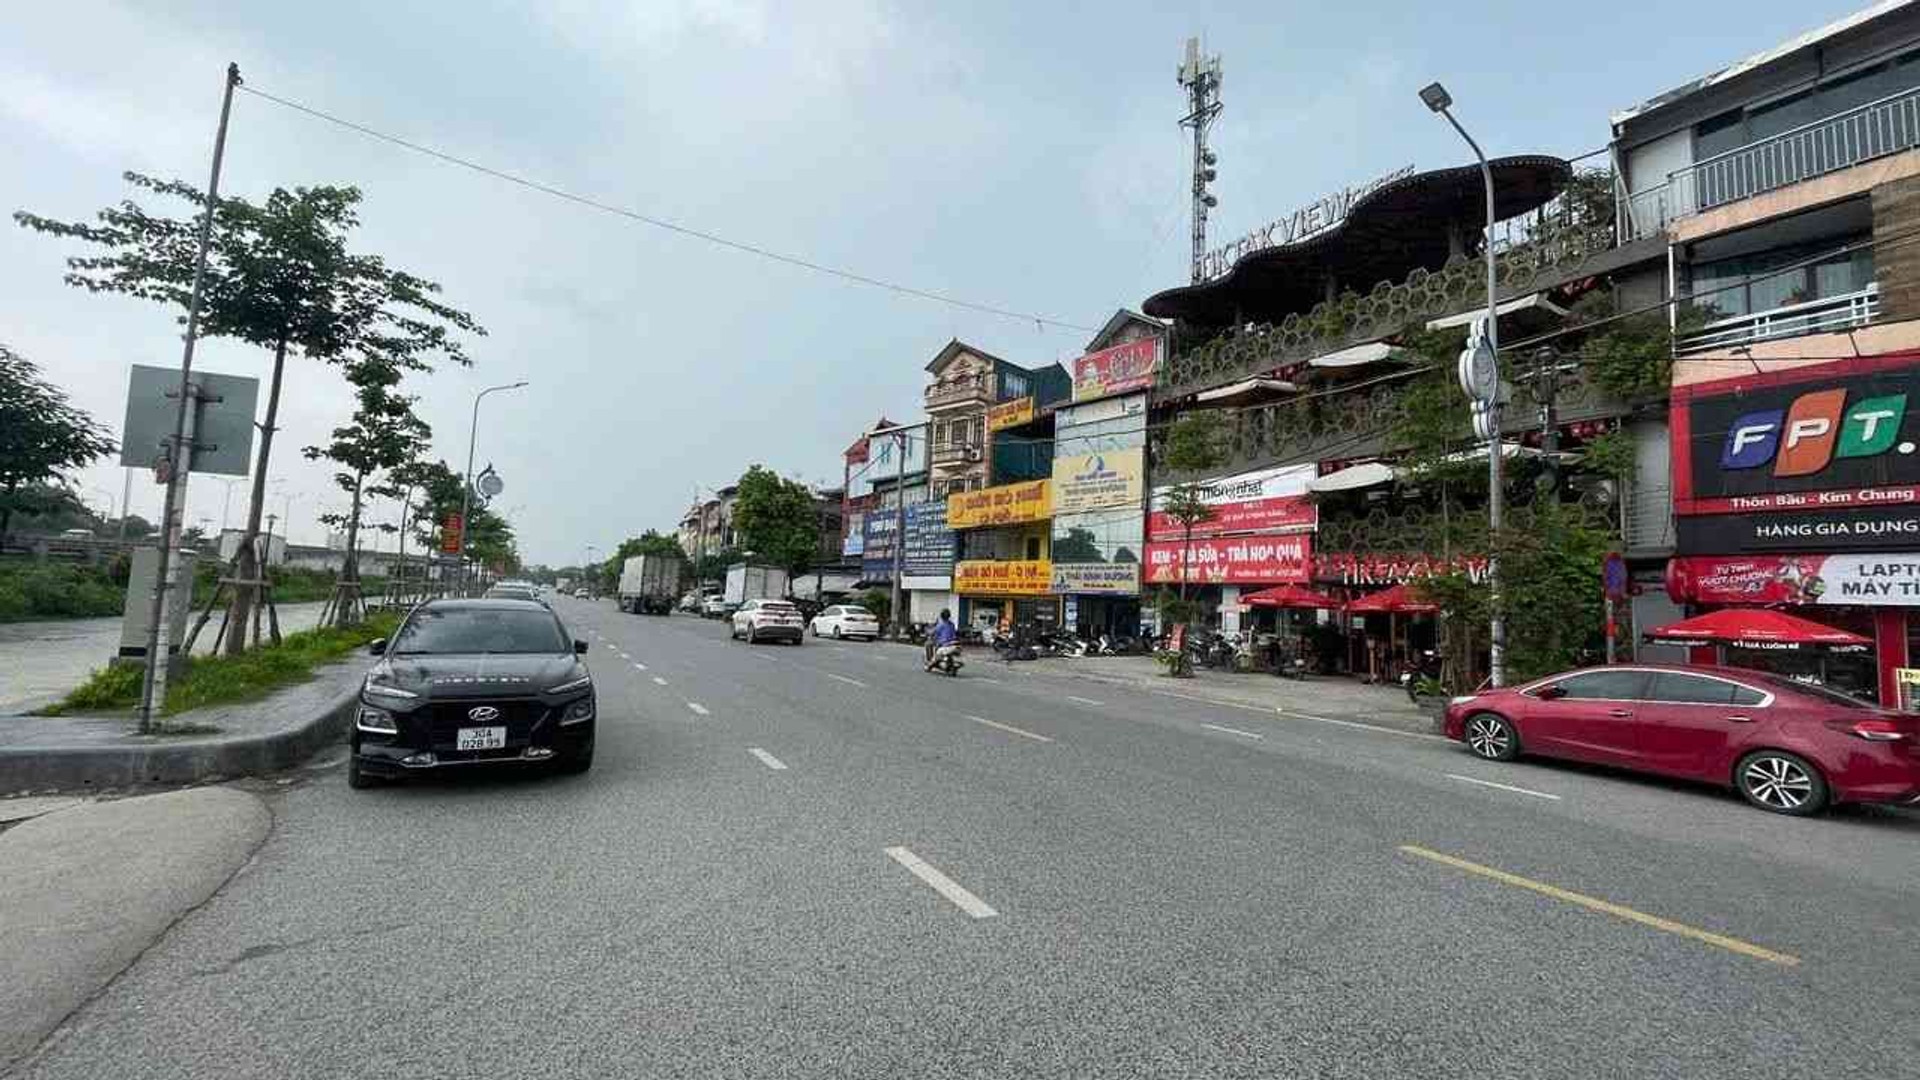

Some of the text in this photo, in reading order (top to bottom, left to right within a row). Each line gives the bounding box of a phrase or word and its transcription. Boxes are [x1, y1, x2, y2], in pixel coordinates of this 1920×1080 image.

[1731, 498, 1770, 508] Thôn
[1819, 491, 1851, 503] Kim
[1857, 489, 1915, 502] Chung
[1756, 520, 1919, 537] HÀNG GIA DỤNG
[1859, 564, 1920, 577] LAPT
[1842, 578, 1892, 596] MÁY
